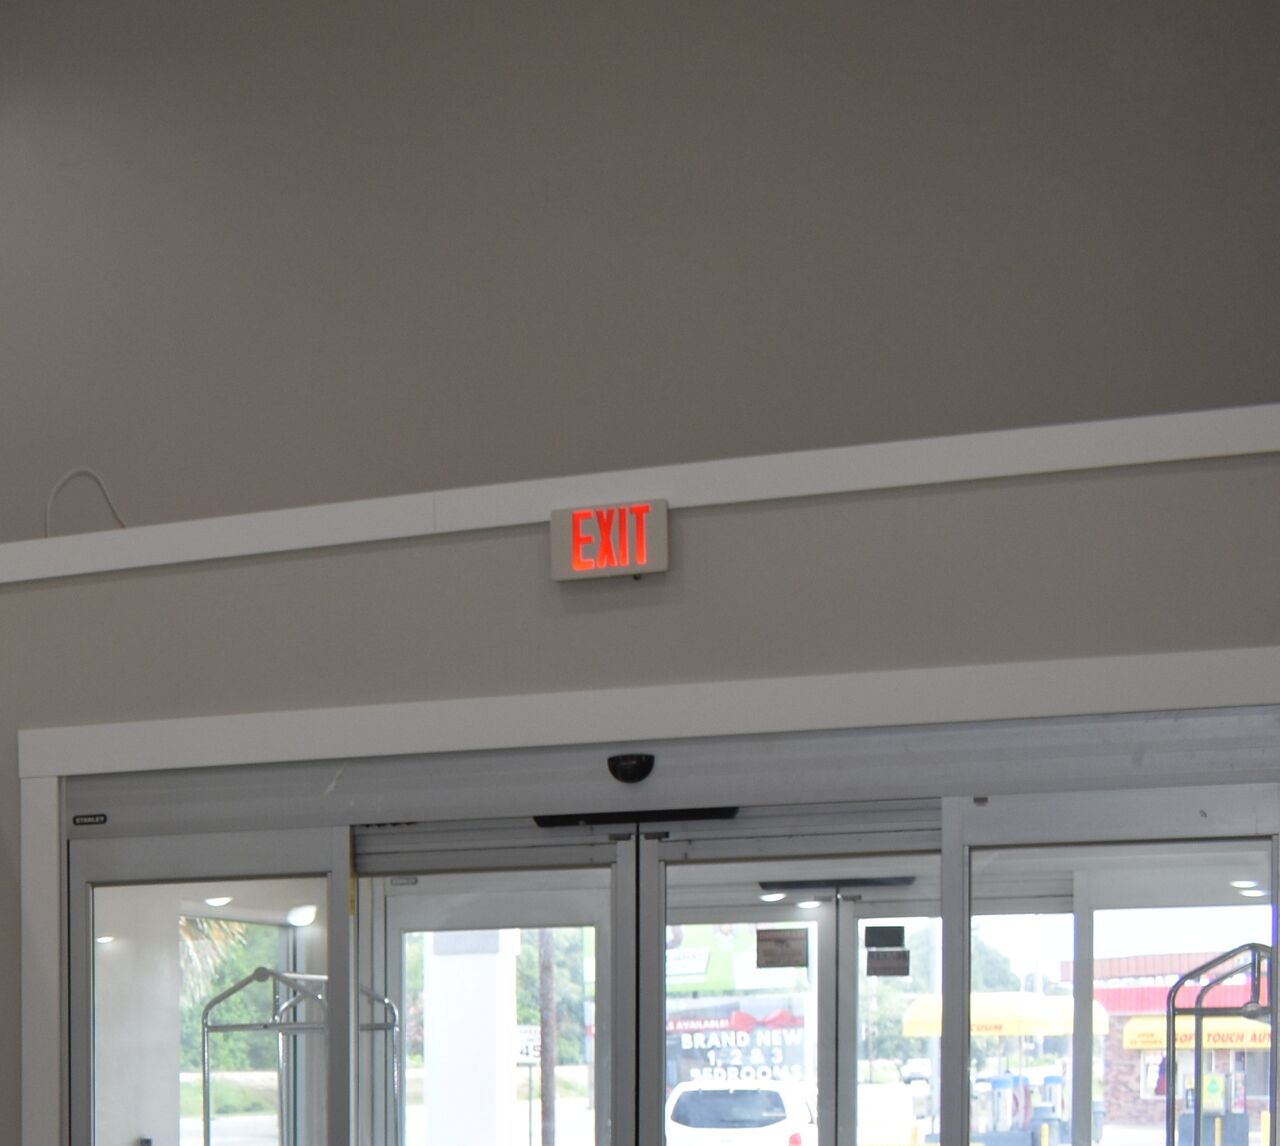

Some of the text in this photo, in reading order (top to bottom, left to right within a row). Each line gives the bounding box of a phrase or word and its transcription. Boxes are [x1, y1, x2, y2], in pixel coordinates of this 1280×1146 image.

[572, 503, 651, 571] EXIT
[681, 1028, 803, 1050] BRAND NEW
[1206, 1032, 1244, 1043] TOUCH
[730, 1048, 743, 1065] 2
[771, 1048, 783, 1063] 3
